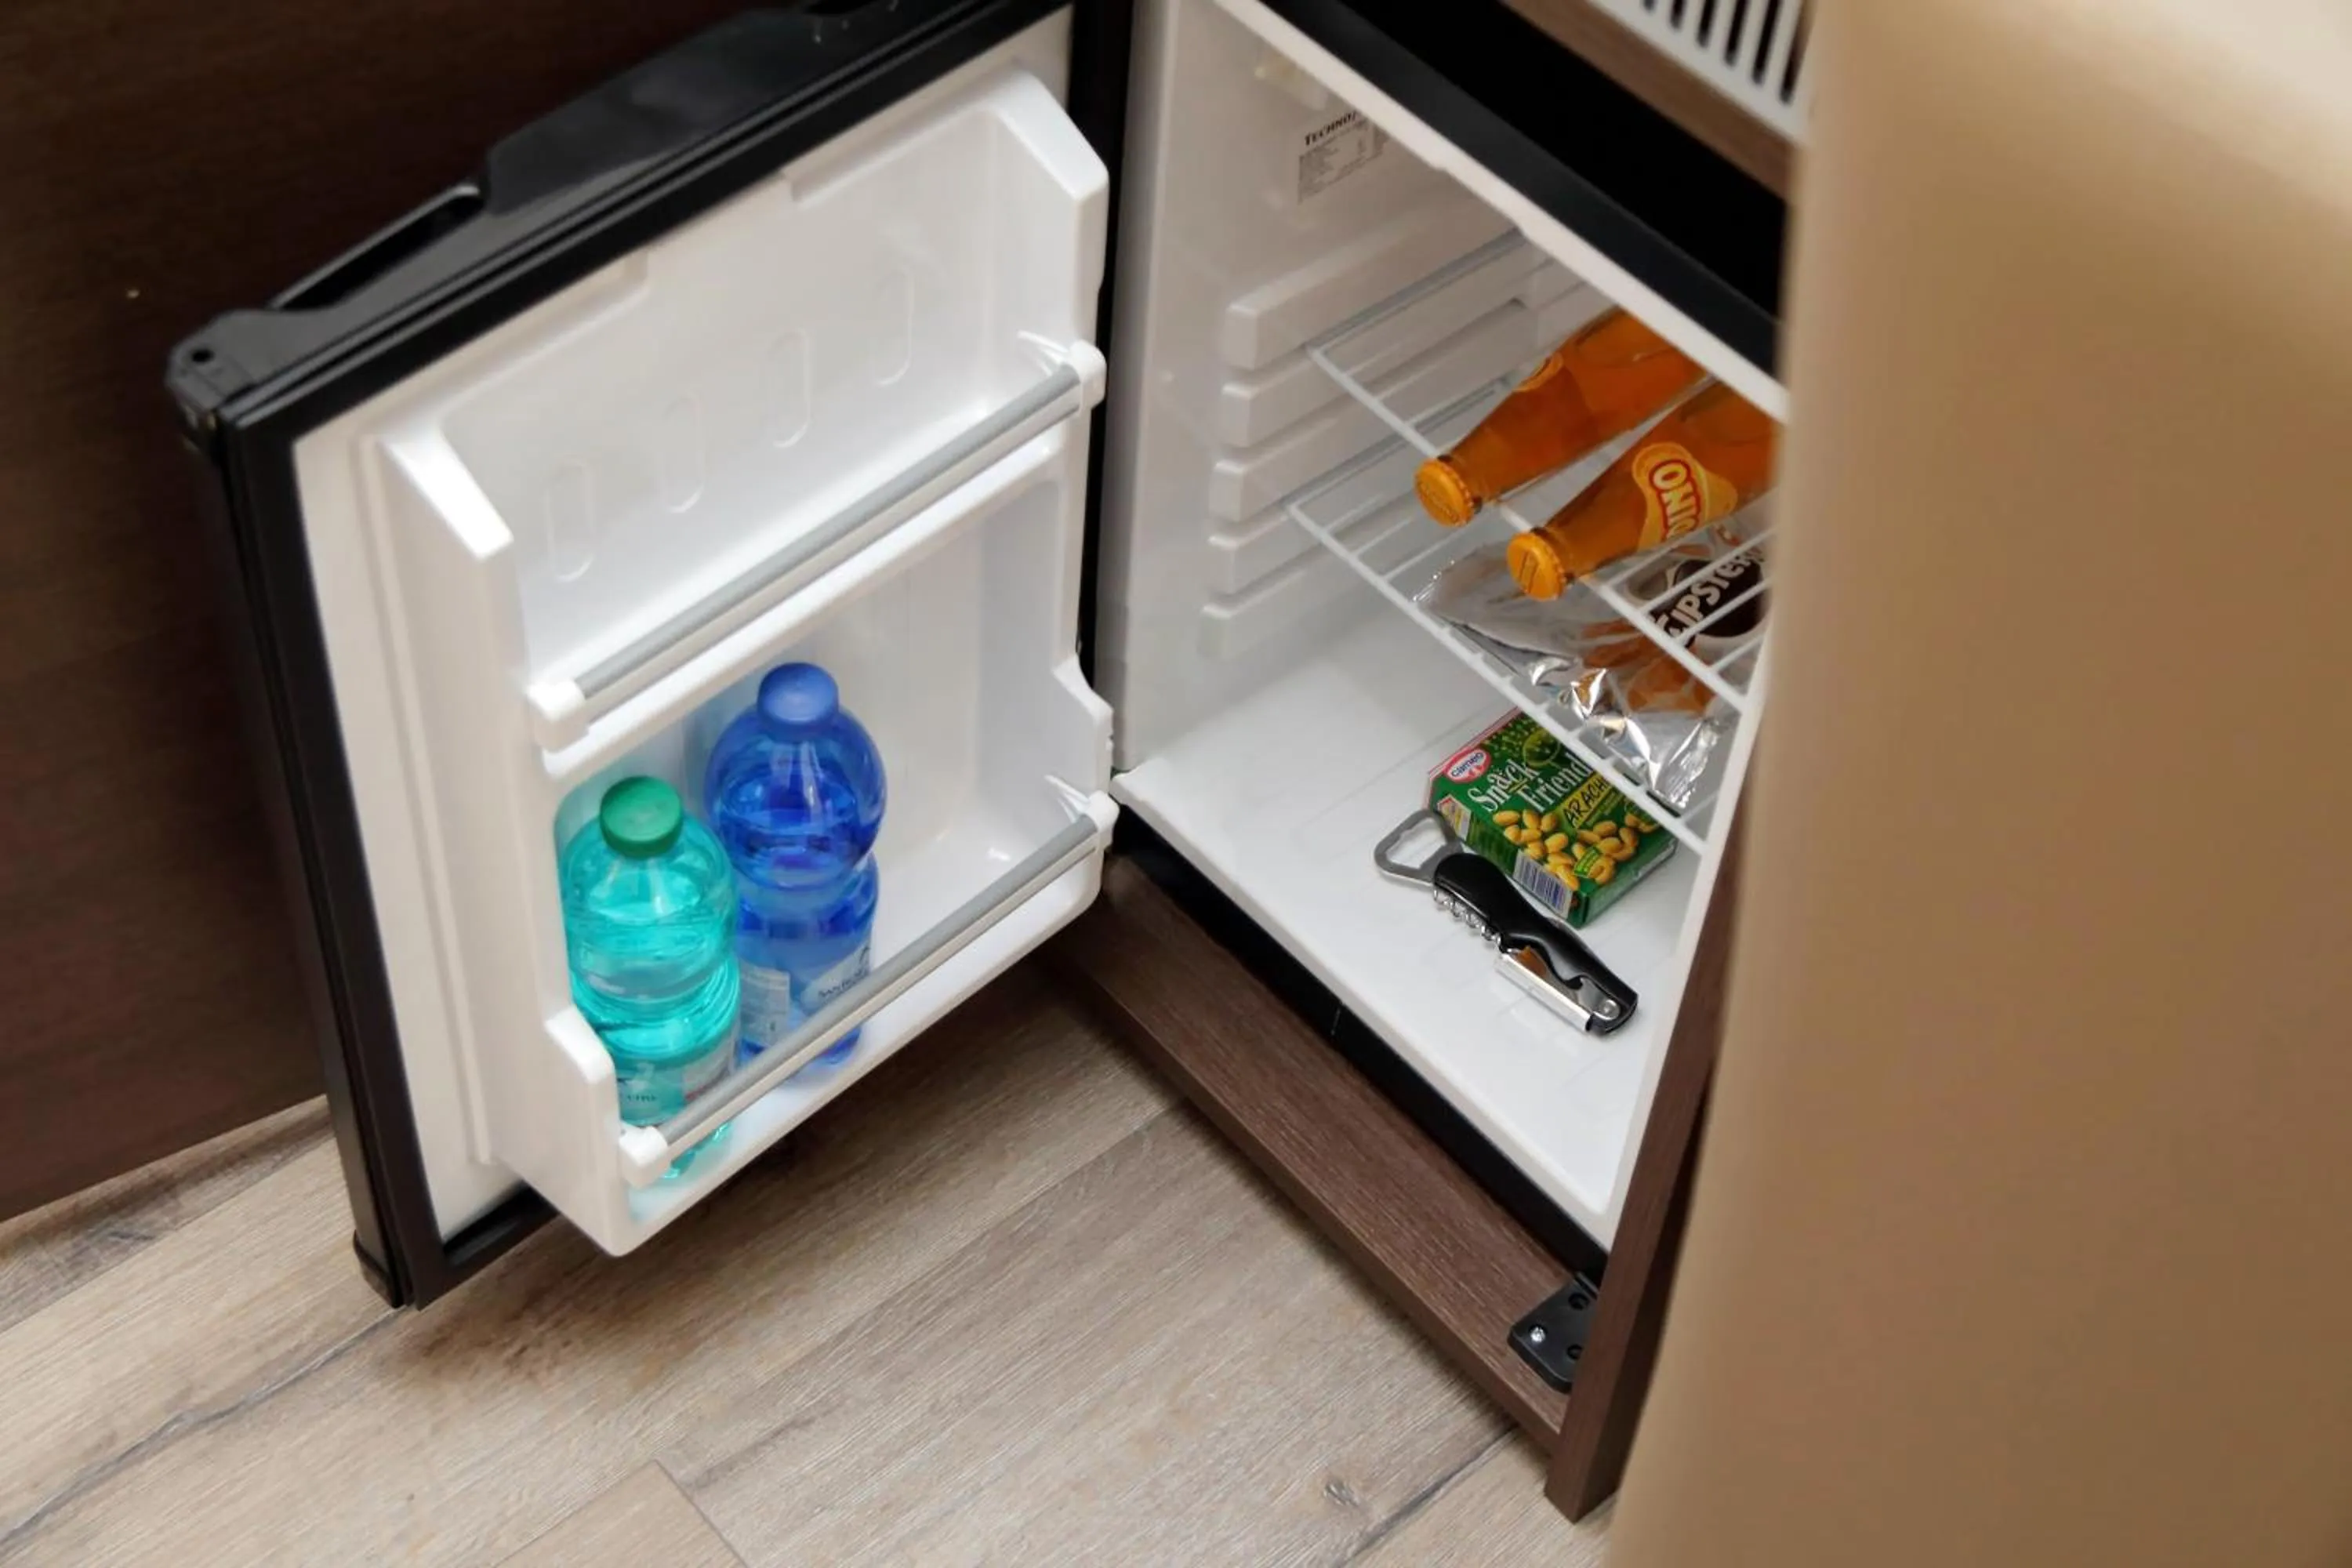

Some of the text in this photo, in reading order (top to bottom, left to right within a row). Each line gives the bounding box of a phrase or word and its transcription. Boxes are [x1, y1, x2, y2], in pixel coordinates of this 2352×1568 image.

[1468, 758, 1540, 812] Snack
[1517, 752, 1595, 813] Friend
[1563, 775, 1608, 828] ARACH
